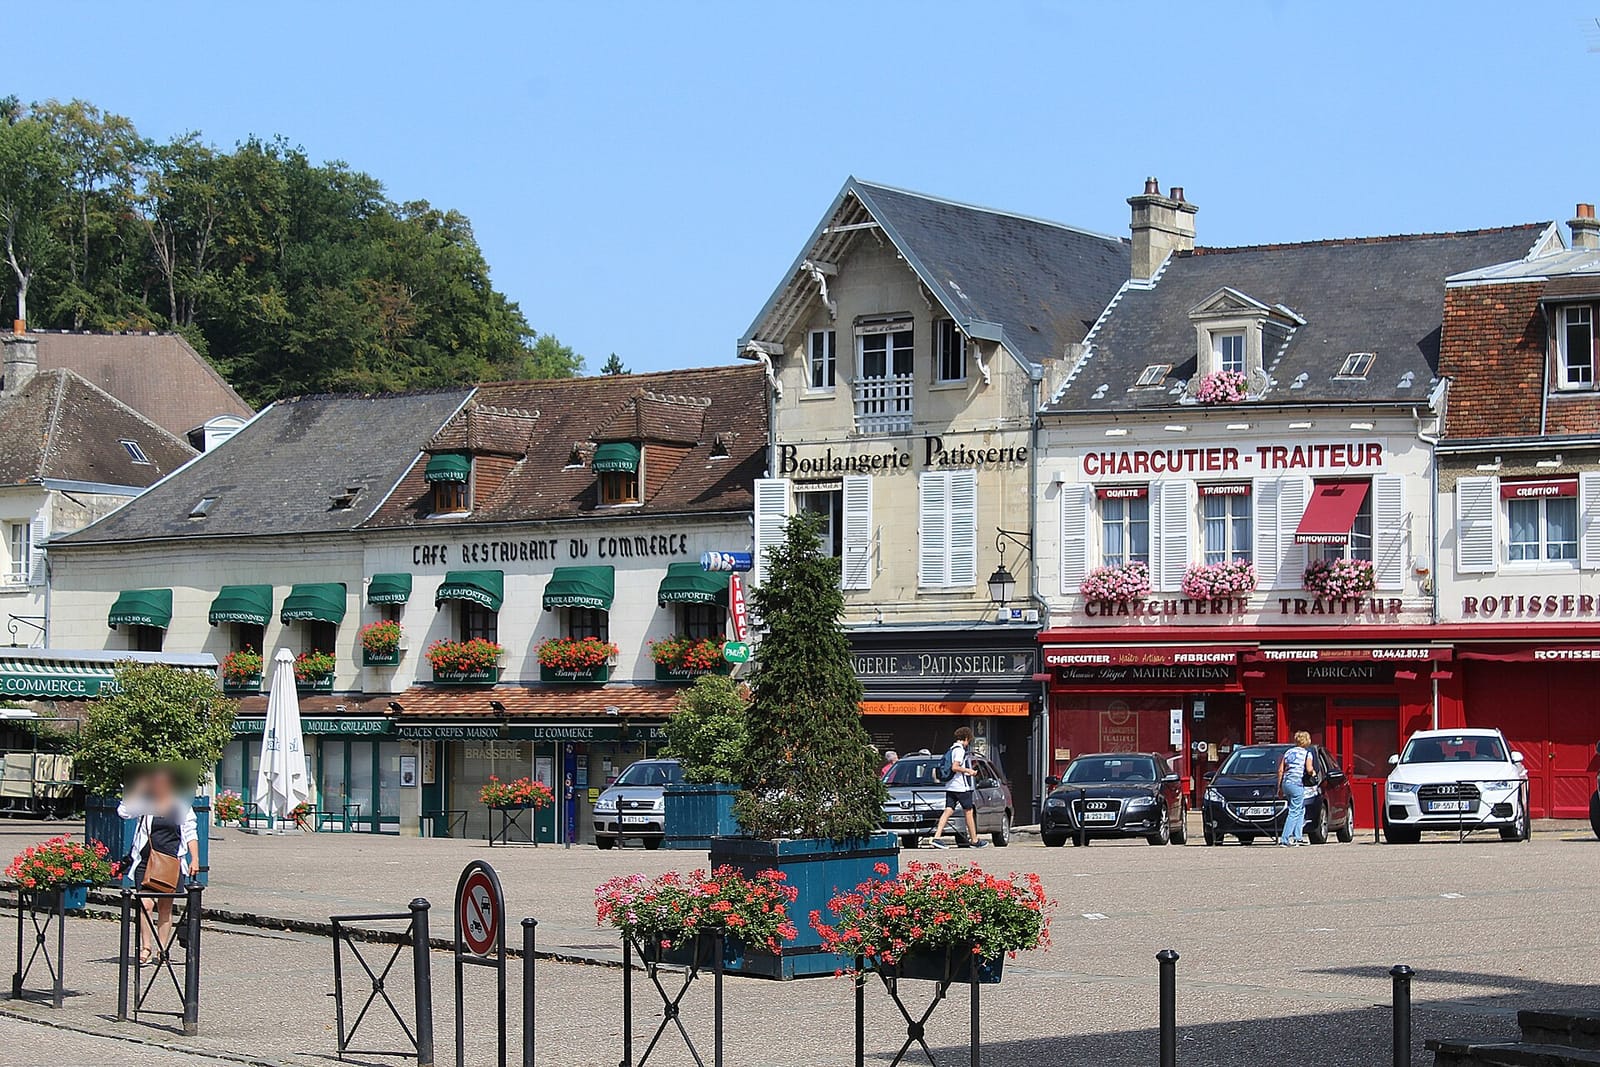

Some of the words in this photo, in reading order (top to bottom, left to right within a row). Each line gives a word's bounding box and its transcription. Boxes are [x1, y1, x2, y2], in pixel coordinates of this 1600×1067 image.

[779, 444, 910, 474] Boulangerie
[923, 436, 1028, 466] Patisserie
[1083, 447, 1239, 476] CHARCUTIER
[1256, 443, 1383, 470] TRAITEUR
[618, 461, 633, 469] 1933
[1106, 488, 1138, 498] QUALITE
[1203, 485, 1245, 495] TRADITION
[1516, 486, 1559, 497] CREATION
[1296, 535, 1347, 543] INNOVATION
[413, 545, 448, 565] CAFE
[462, 539, 558, 564] RESTAURANT
[598, 533, 688, 559] COMMERCE
[734, 577, 747, 639] TABAC
[1084, 597, 1249, 617] CHARCUTERIE
[1278, 597, 1403, 616] TRAITEUR
[1463, 594, 1600, 614] ROTISSER
[283, 610, 313, 618] ANQUETS
[1046, 654, 1110, 664] CHARCUTIER
[1174, 652, 1236, 663] FABRICANT
[1264, 650, 1319, 660] TRAITEUR
[850, 656, 898, 674] NGERIE
[918, 654, 1006, 676] PATISSERIE
[1132, 667, 1177, 679] MAITRE
[1178, 666, 1230, 678] ARTISAN
[1306, 666, 1376, 678] FABRICANT
[6, 678, 86, 692] COMMERCE
[972, 703, 1024, 714] CONFISEUR
[308, 721, 338, 731] MOULES
[340, 720, 382, 731] GRILLADES
[403, 727, 432, 737] GLACES
[435, 727, 464, 737] CREPES
[467, 727, 499, 737] MAISON
[534, 727, 543, 738] LE
[545, 727, 594, 738] COMMERCE
[465, 748, 521, 760] BRASSERIE
